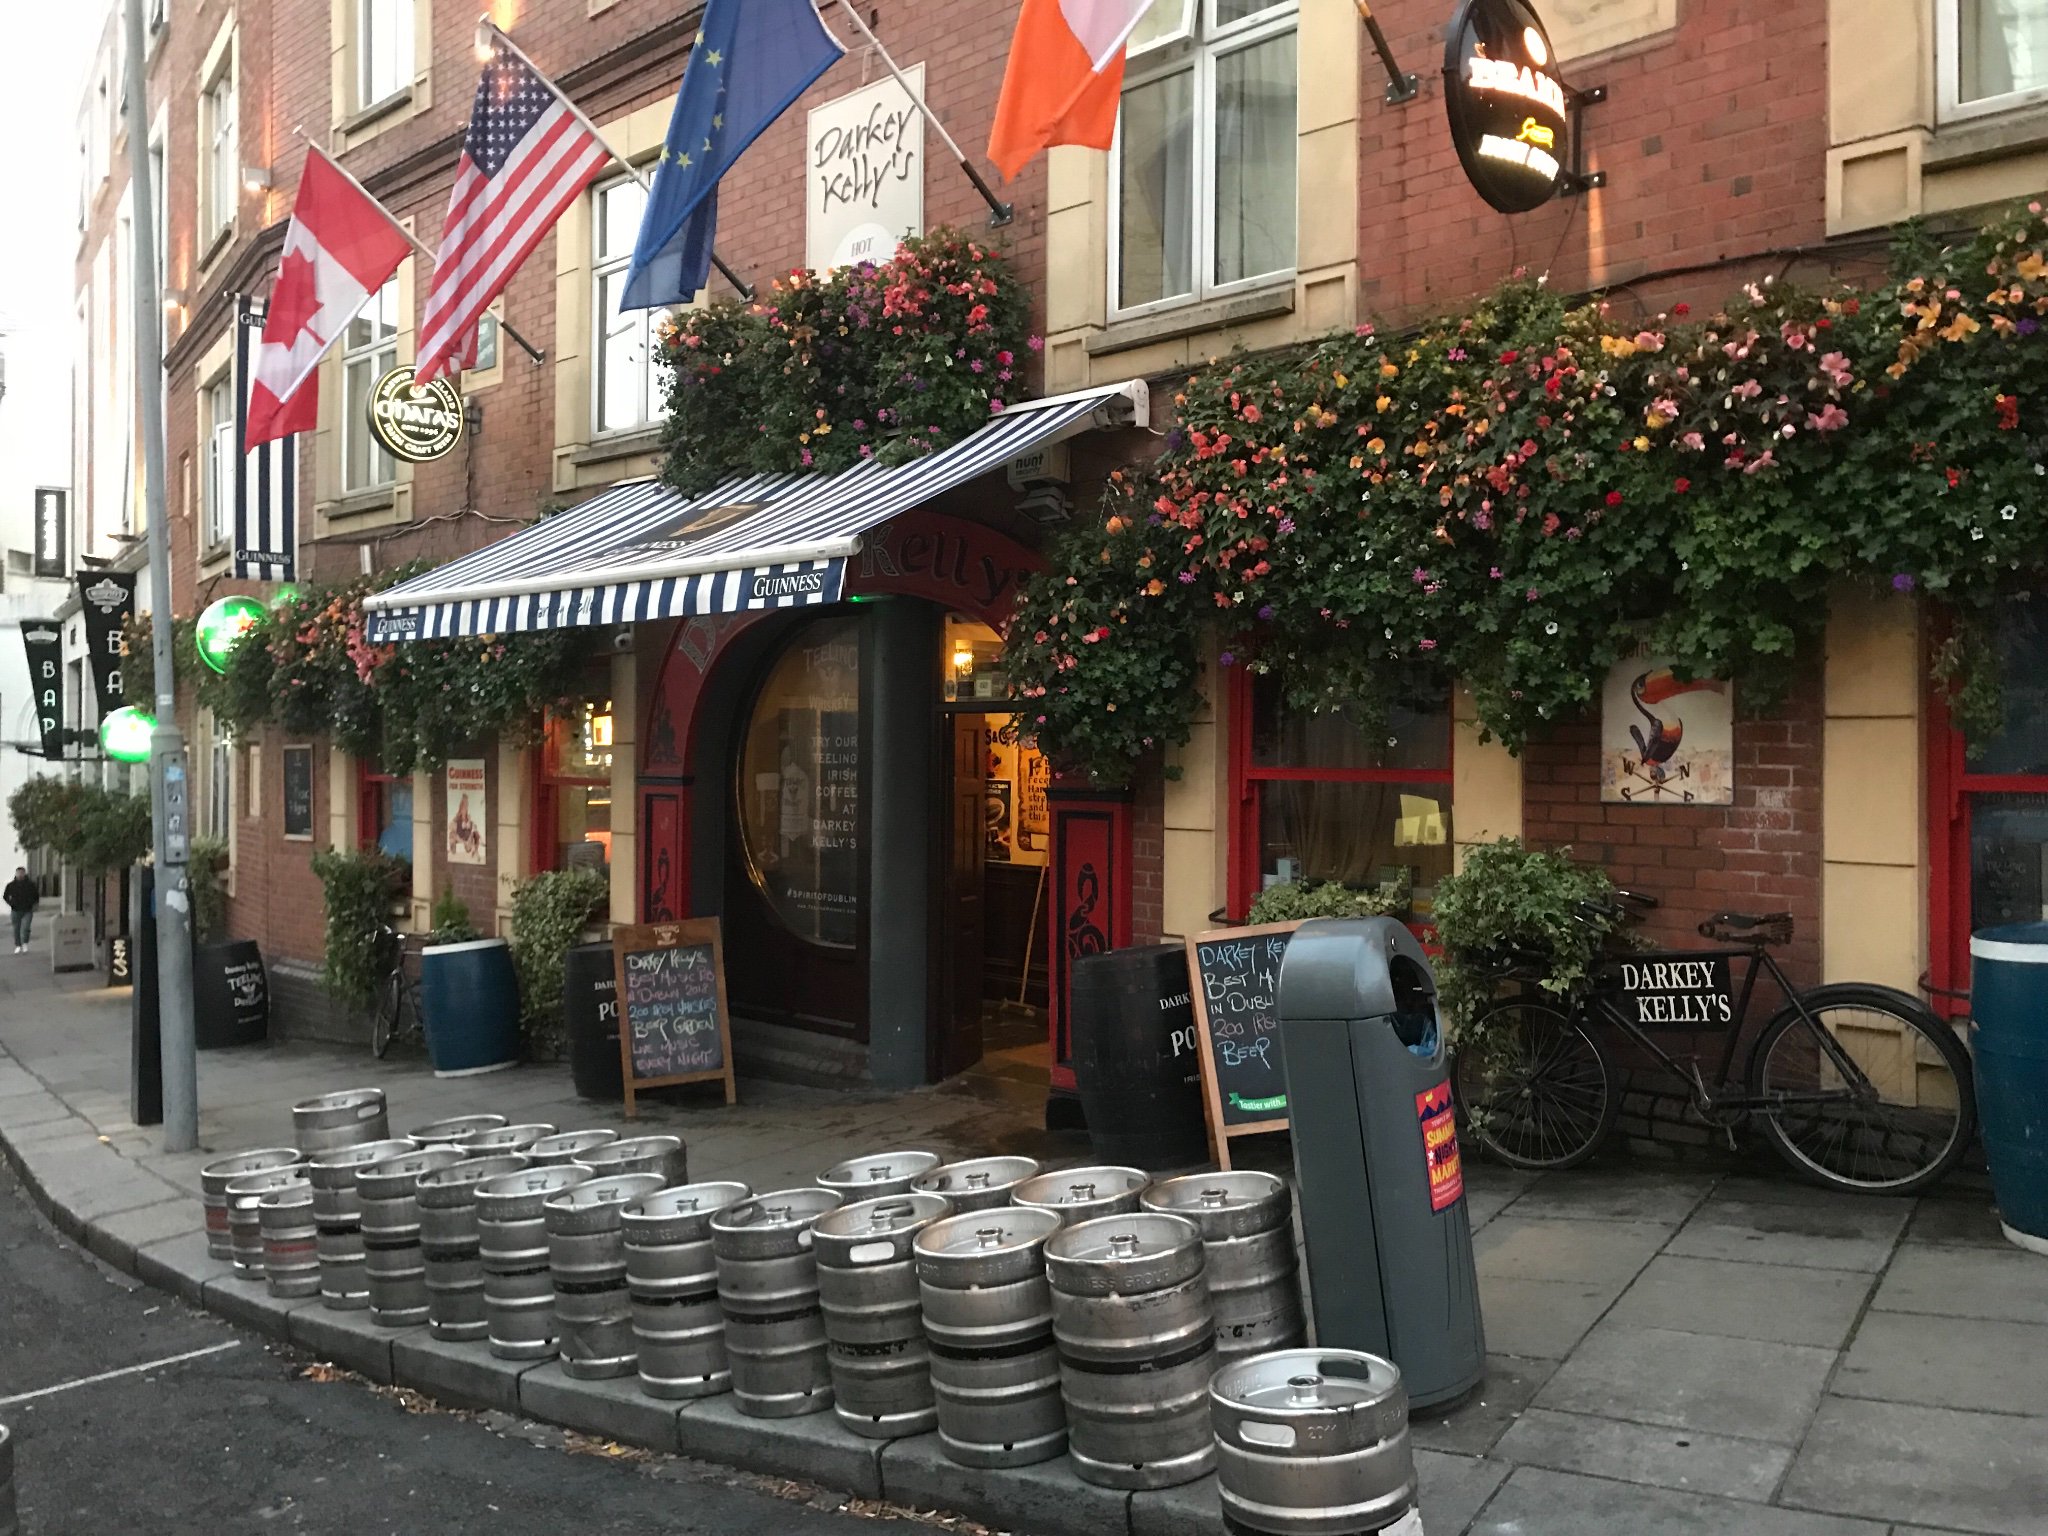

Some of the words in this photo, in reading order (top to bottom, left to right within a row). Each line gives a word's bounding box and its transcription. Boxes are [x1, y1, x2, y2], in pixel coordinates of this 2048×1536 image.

[815, 102, 916, 168] Darkey
[821, 151, 914, 213] Kelly's
[851, 237, 873, 257] HOT
[236, 550, 292, 565] GUINNESS
[754, 572, 824, 598] GUINNESS
[377, 617, 417, 634] GUINNESS
[827, 768, 857, 781] IRISH
[1622, 756, 1636, 776] W
[1679, 761, 1691, 780] N
[816, 786, 858, 798] COFFEE
[842, 804, 857, 815] AT
[1199, 942, 1256, 975] DARKEY
[1203, 972, 1249, 1000] BEST
[1621, 961, 1716, 990] DARKEY
[1210, 1004, 1222, 1015] IN
[1636, 993, 1731, 1022] KELLY'S
[1213, 1018, 1244, 1039] 200
[1239, 1099, 1263, 1110] Tastier
